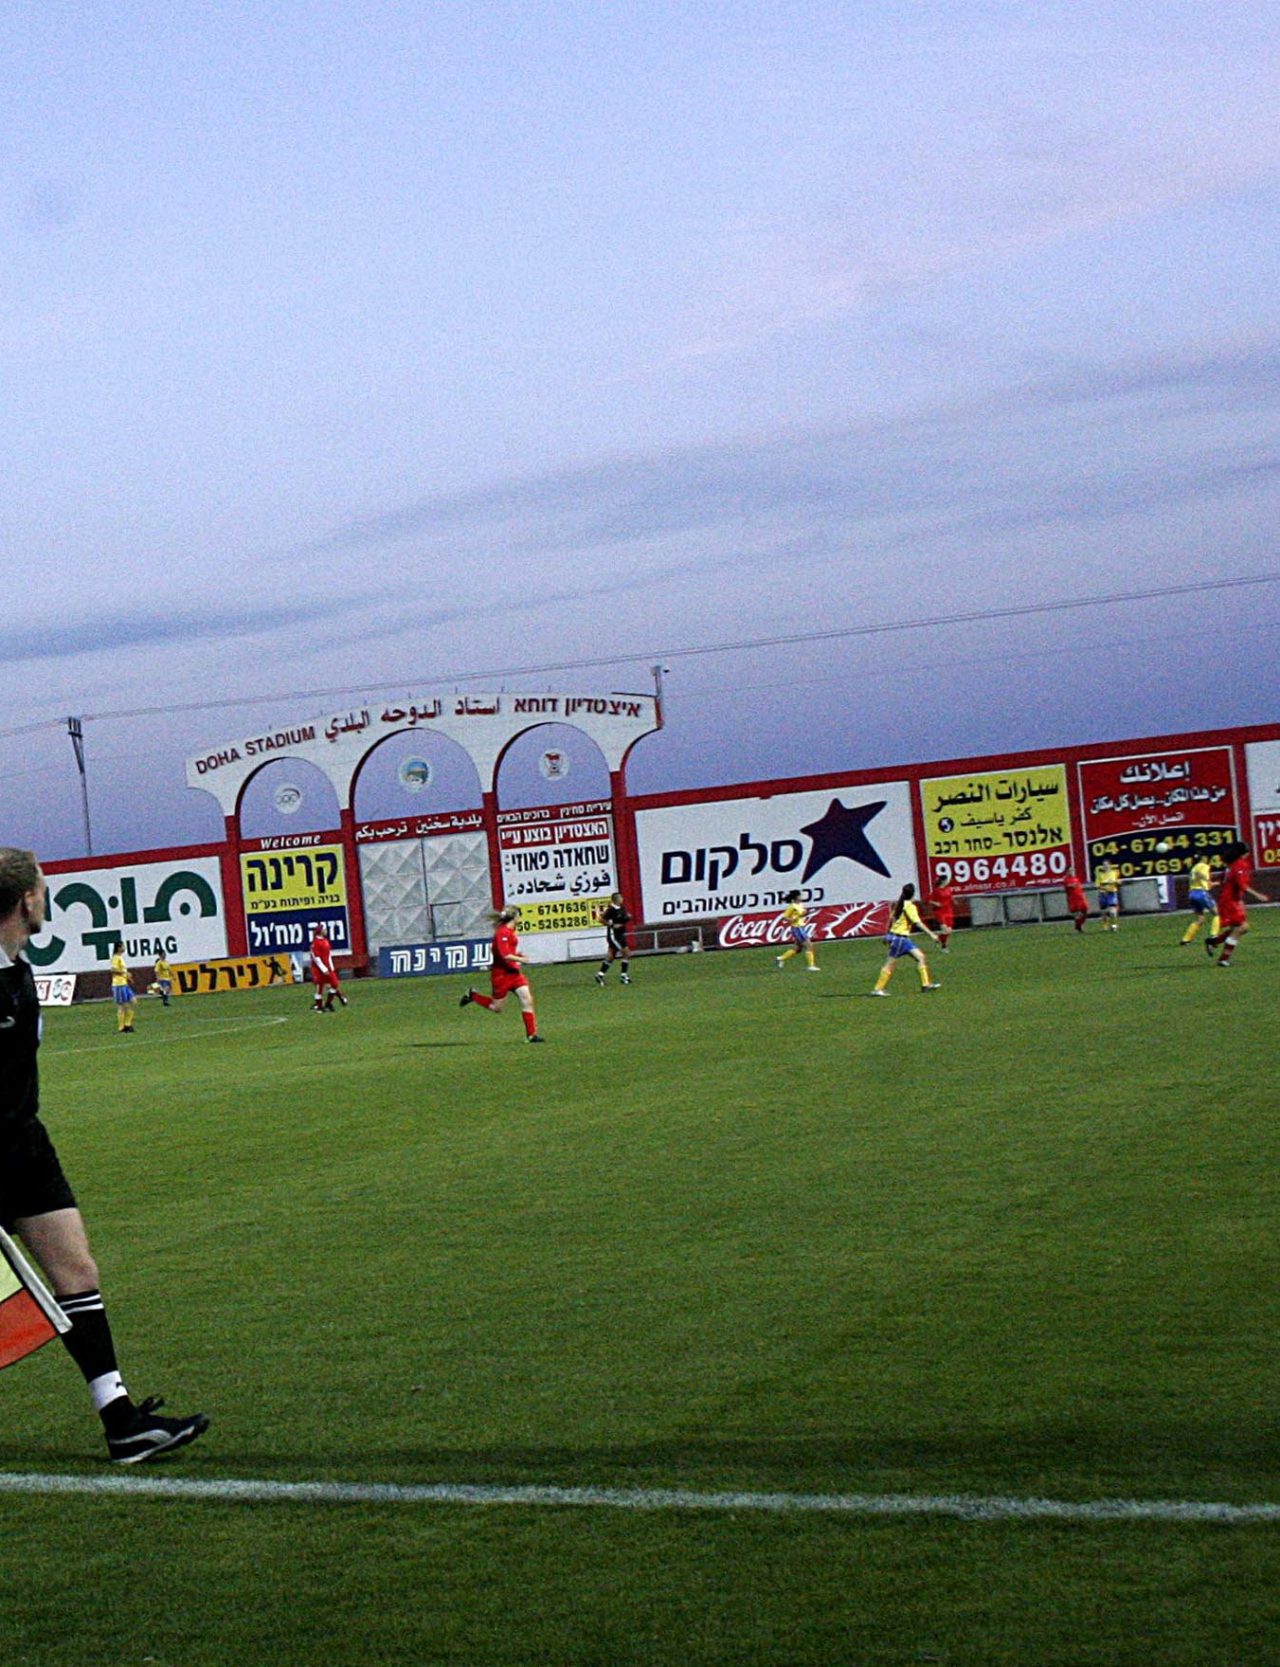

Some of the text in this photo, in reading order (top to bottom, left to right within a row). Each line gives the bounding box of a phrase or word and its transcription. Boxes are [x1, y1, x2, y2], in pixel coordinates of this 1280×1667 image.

[514, 698, 641, 717] איצטדיון דוחא
[324, 710, 370, 742] البلدي
[195, 726, 316, 774] DOHA STADIUM
[932, 778, 1059, 813] سيارات النصر
[376, 821, 408, 838] ترحب
[450, 814, 483, 829] بلدية
[260, 835, 321, 849] Welcome
[355, 825, 376, 841] بكم
[523, 827, 552, 843] בוצע
[1003, 823, 1063, 847] אלנסר
[553, 845, 609, 868] שחאדה
[934, 840, 960, 854] רכב
[511, 850, 550, 872] פאוזי
[661, 833, 803, 891] סלקום
[935, 850, 1066, 883] 9964480
[247, 852, 338, 893] קרינה
[516, 869, 611, 896] فوزي شحاده
[280, 896, 315, 907] ופיתוח
[318, 894, 340, 905] בניה
[538, 901, 587, 915] 6747636
[663, 891, 759, 915] כשאוהבים
[516, 916, 588, 932] 50-5263286
[126, 935, 178, 957] URAG
[390, 943, 494, 973] עמינח
[177, 963, 259, 993] נירלט
